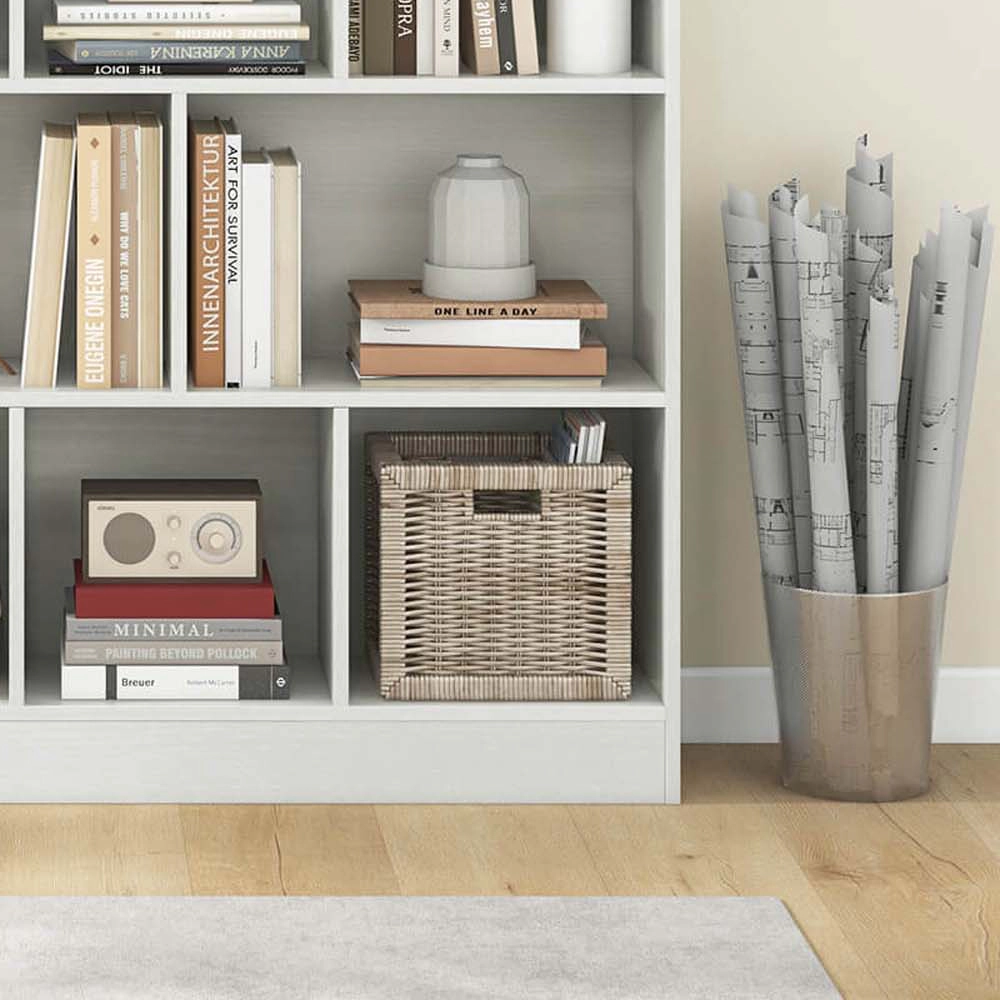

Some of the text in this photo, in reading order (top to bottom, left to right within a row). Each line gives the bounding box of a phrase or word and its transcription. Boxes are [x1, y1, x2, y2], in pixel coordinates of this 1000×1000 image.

[150, 46, 236, 60] KARENINA
[241, 45, 291, 59] ANNA
[94, 65, 162, 75] THE IDIOT
[227, 144, 239, 285] ART FOR SURVIVAL
[202, 134, 220, 352] INNENARCHITEKTUR
[119, 211, 130, 319] WHY DO WE LOVE CATS
[434, 307, 538, 316] ONE LINE A DAY
[84, 258, 105, 384] EUGENE ONEGIN
[113, 623, 214, 637] MINIMAL
[105, 647, 157, 660] PAINTING
[159, 647, 205, 660] BEYOND
[207, 647, 258, 660] POLLOCK
[121, 678, 155, 687] Breuer
